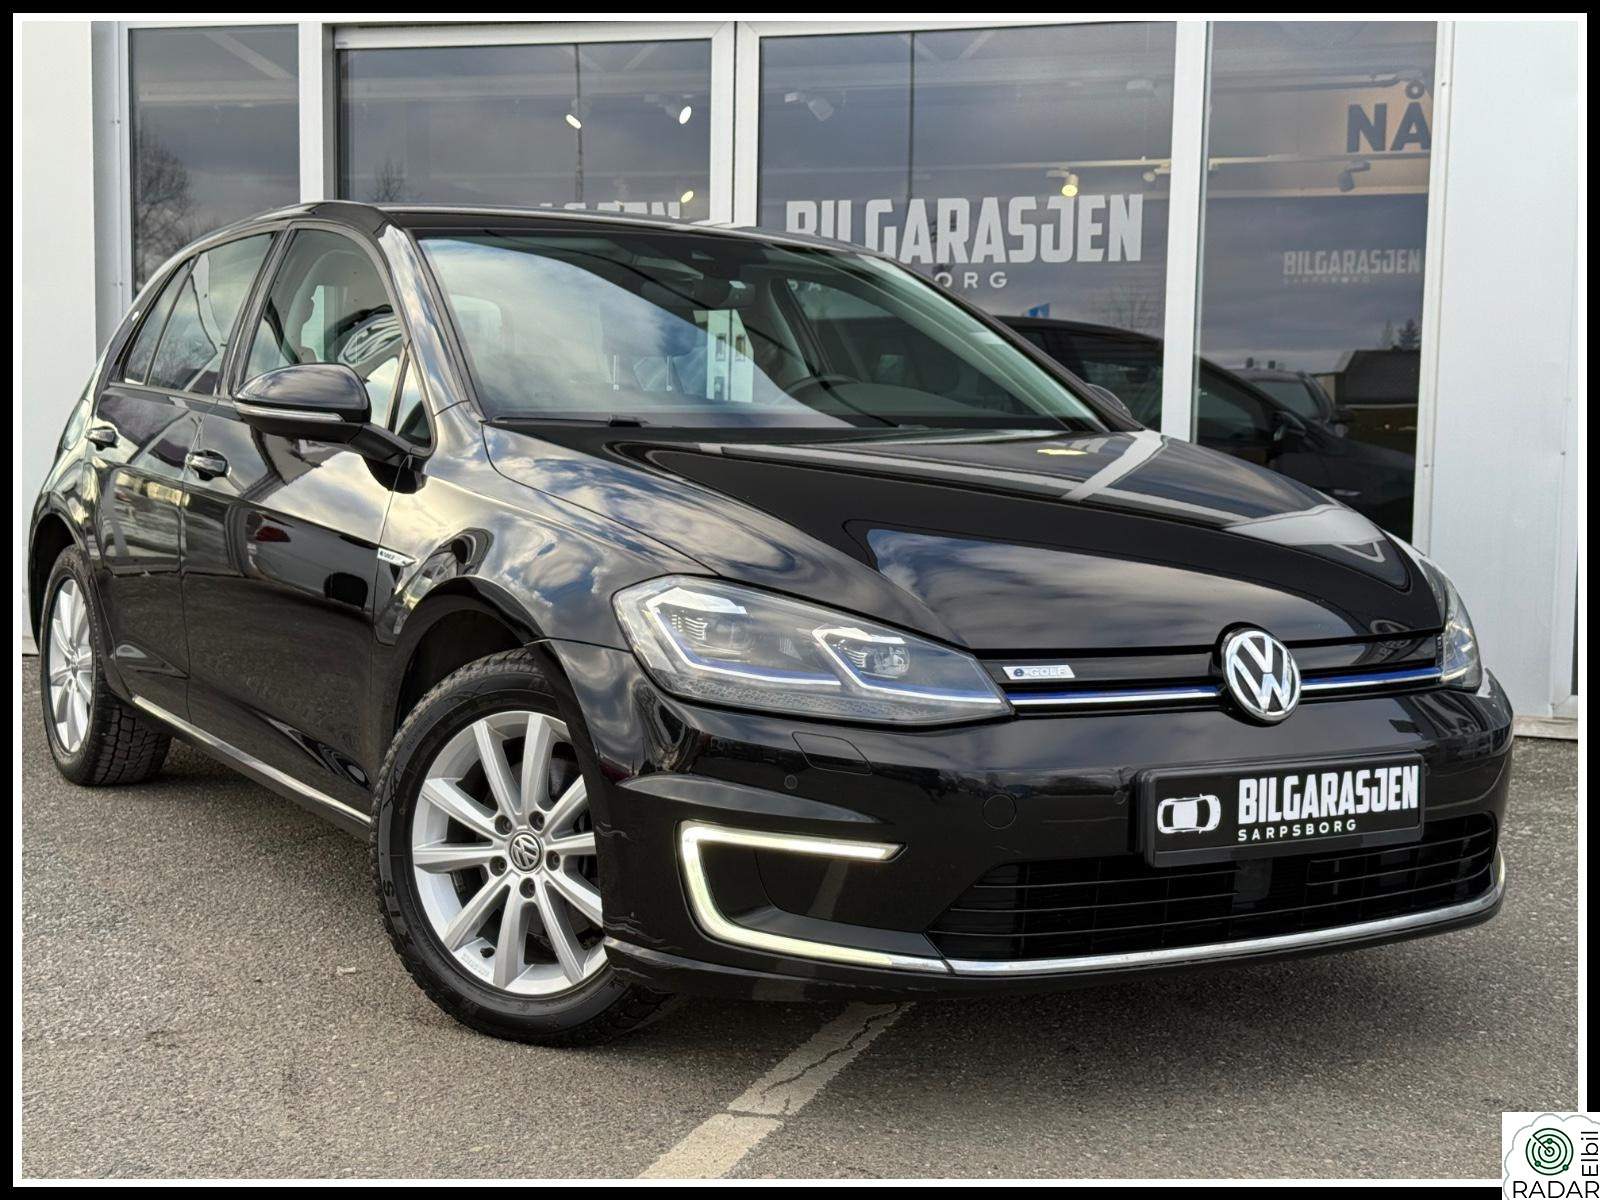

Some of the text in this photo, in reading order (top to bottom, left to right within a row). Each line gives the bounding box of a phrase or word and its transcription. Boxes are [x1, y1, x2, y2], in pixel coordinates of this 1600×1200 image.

[1283, 249, 1421, 275] BILGARASJEN
[1238, 765, 1419, 825] BILGARASJEN
[1238, 819, 1357, 842] SARPSBORG
